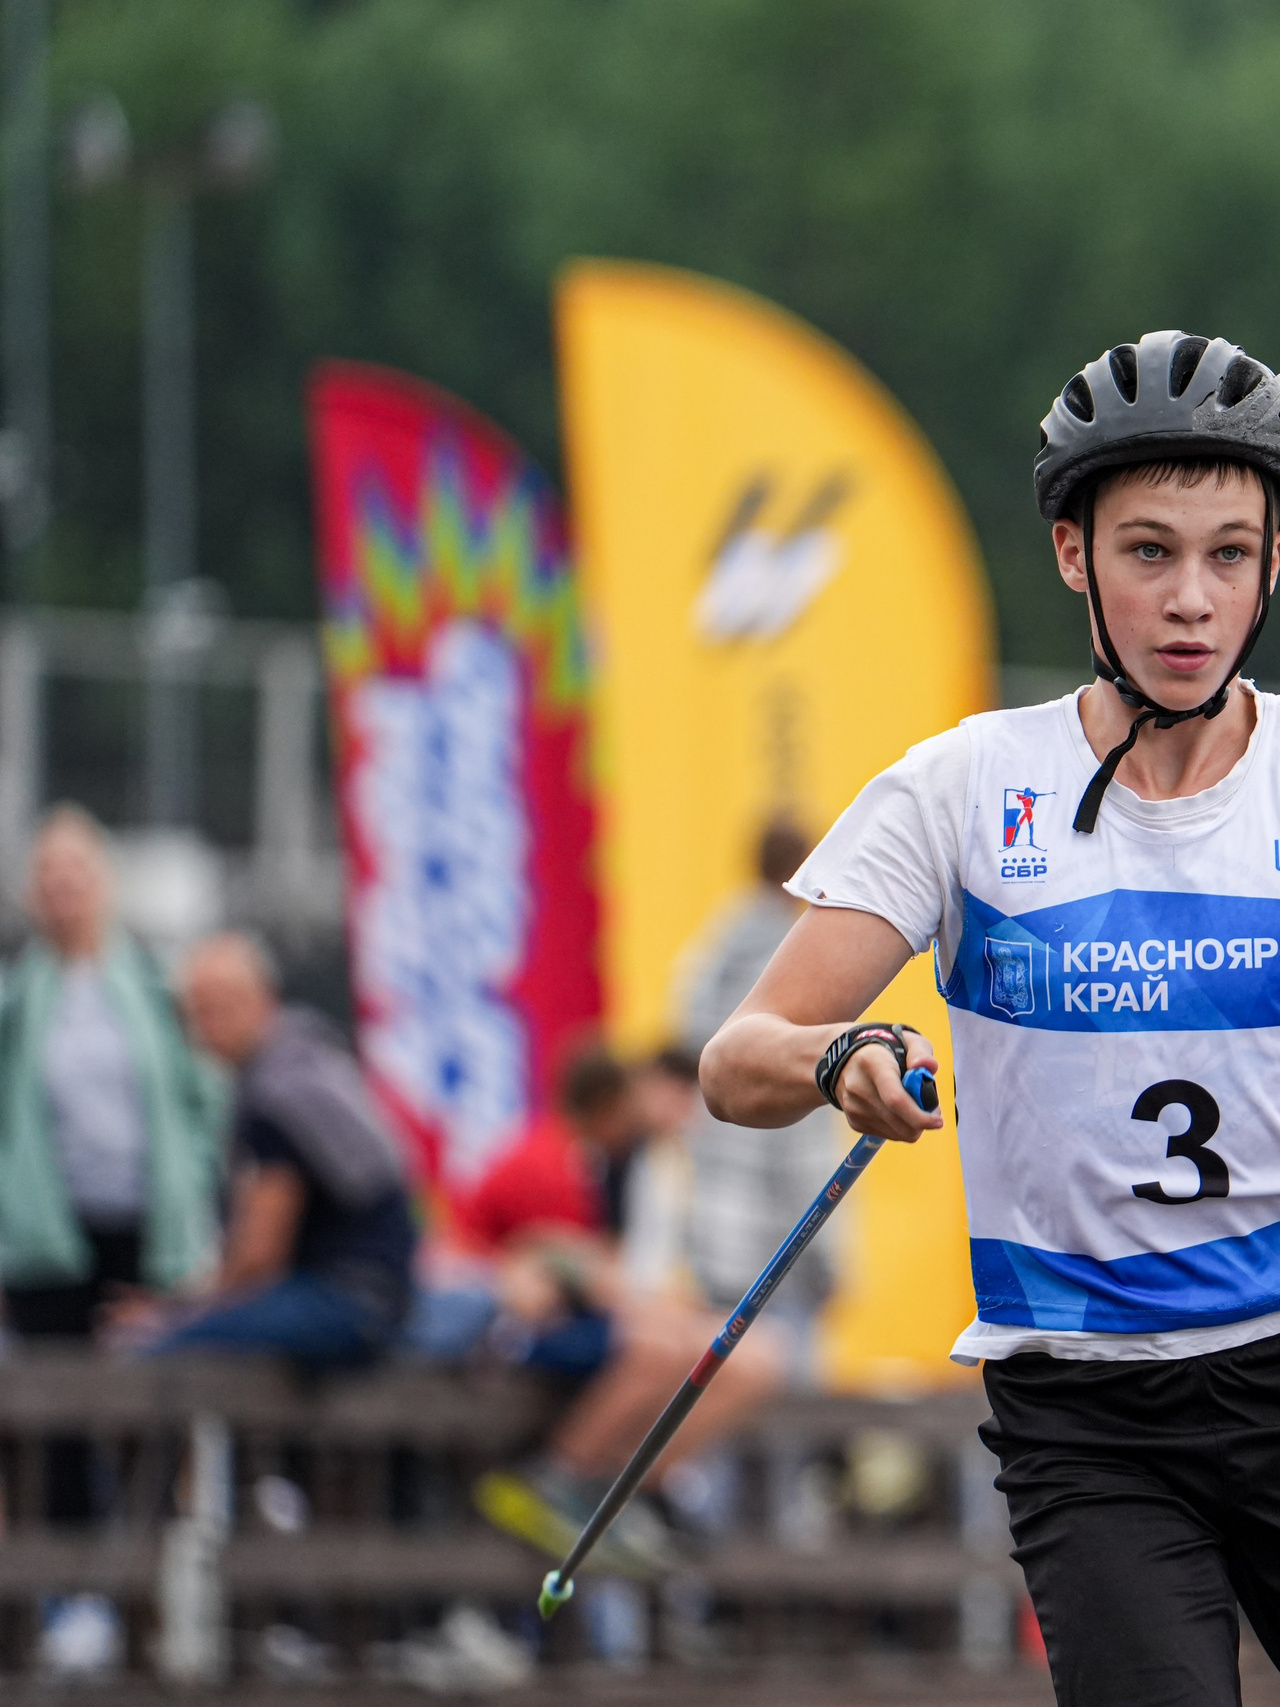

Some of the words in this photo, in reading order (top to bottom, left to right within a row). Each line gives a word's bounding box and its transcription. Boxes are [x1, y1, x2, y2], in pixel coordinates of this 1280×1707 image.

[1001, 865, 1048, 878] СБР
[1063, 973, 1169, 1013] КРАЙ
[1130, 1078, 1230, 1205] 3
